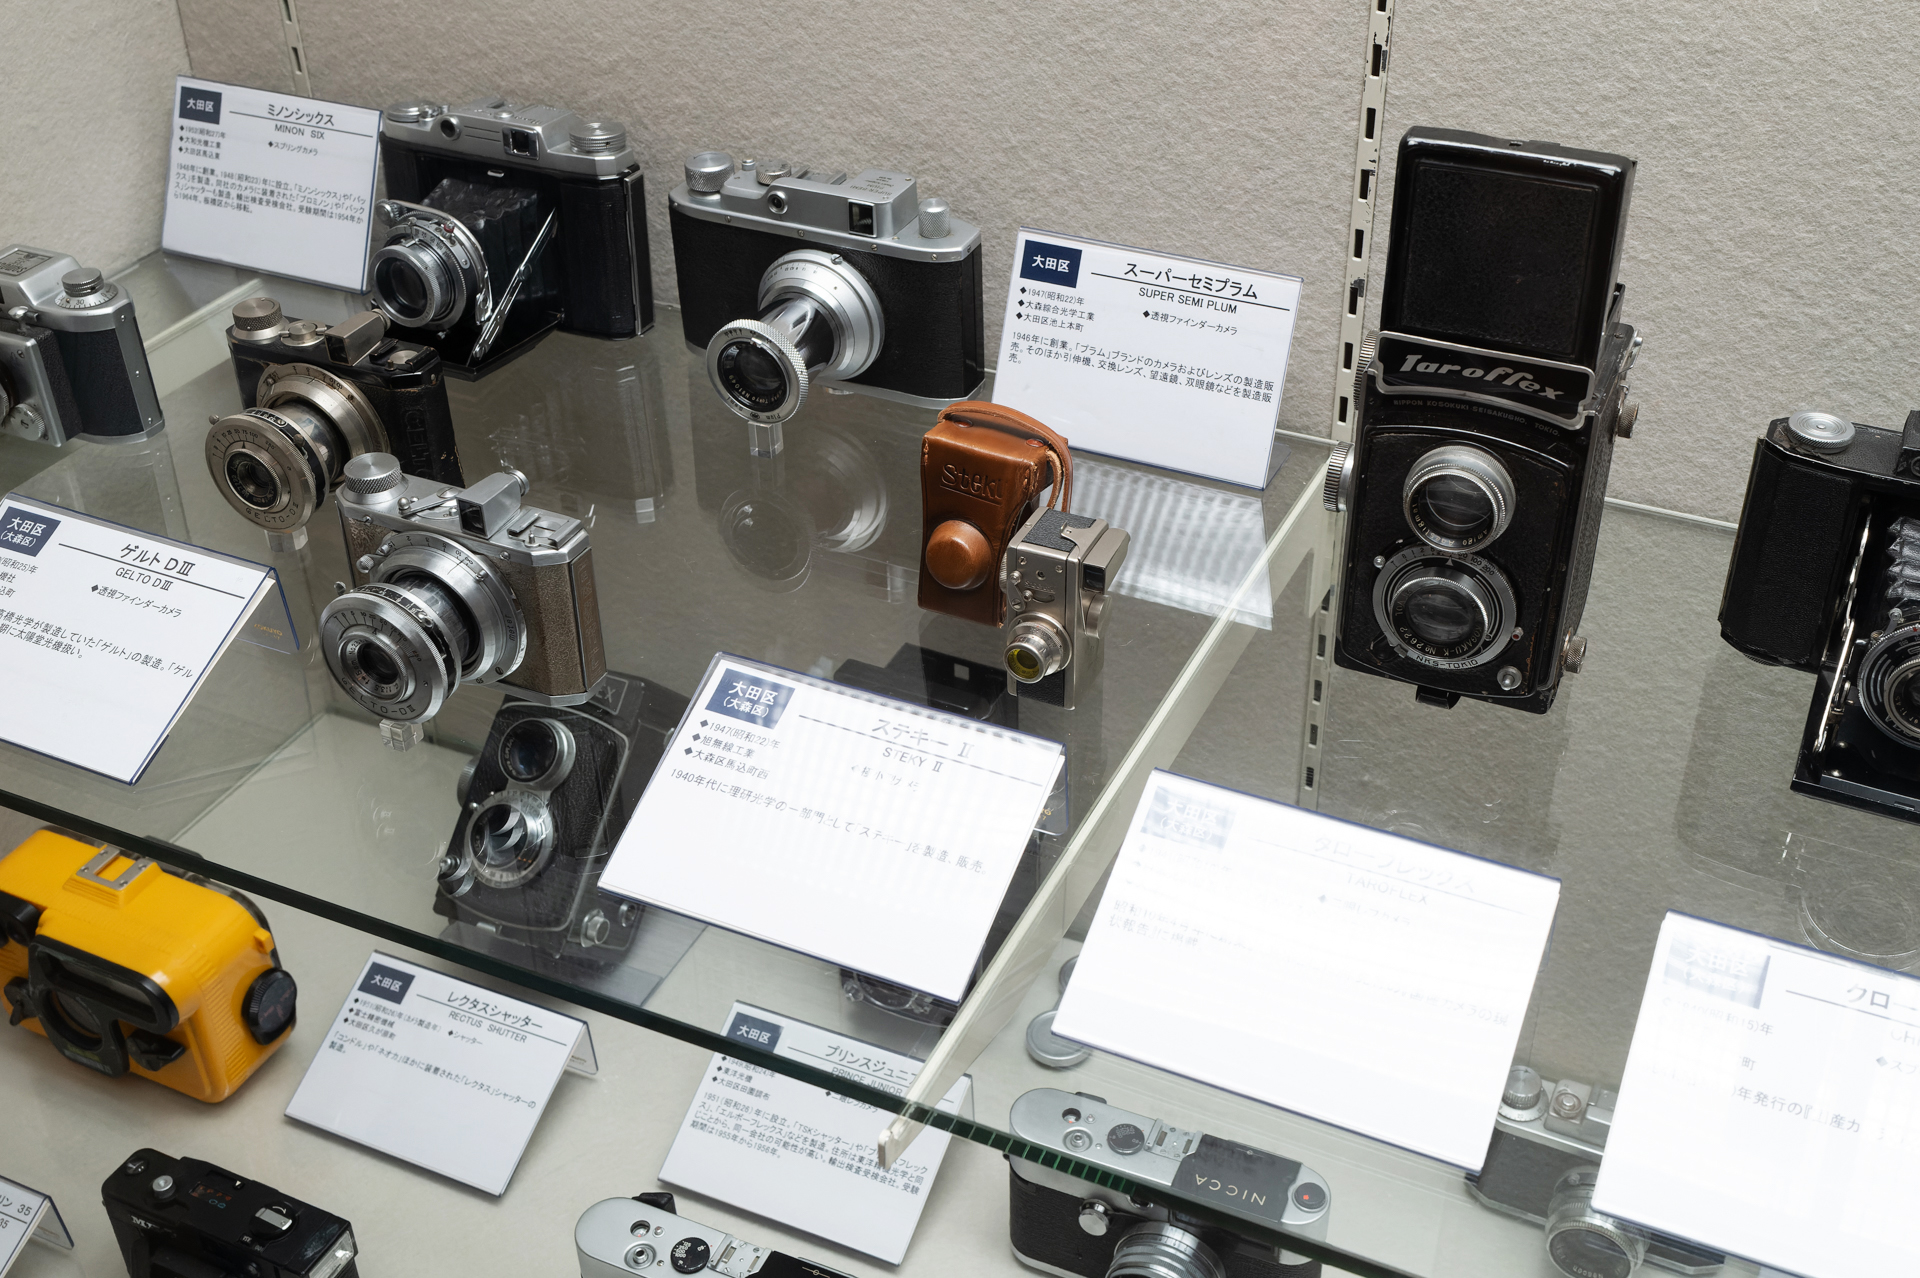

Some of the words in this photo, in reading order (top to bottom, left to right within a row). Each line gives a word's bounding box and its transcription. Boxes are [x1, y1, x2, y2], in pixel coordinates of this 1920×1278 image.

[186, 97, 214, 112] 大田区
[267, 102, 335, 127] ミノンシックス
[274, 123, 304, 136] MINON
[310, 129, 324, 140] SIX
[273, 141, 318, 156] スプリングカメラ
[1031, 254, 1070, 273] 大田区
[1123, 260, 1260, 300] スーパーセミプラム
[1026, 287, 1085, 307] 1947(昭和22)年
[1138, 286, 1175, 302] SUPER
[1177, 293, 1204, 308] SEMI
[1206, 299, 1237, 314] PLUM
[1023, 312, 1084, 332] 大田区池上本町
[1149, 310, 1238, 336] 透視ファインダーカメラ
[1008, 352, 1022, 364] 売。
[6, 515, 47, 536] 大田区
[116, 542, 166, 568] ゲルト
[113, 566, 152, 584] GELTO
[96, 585, 183, 618] 透視ファインダーカメラ
[1416, 654, 1479, 669] NKS-TOKIO
[728, 680, 779, 704] 大田区
[699, 734, 756, 759] 旭無線工業
[706, 721, 781, 751] 1947(昭和22)年
[870, 716, 952, 753] ステキー
[691, 748, 771, 780] 大森区馬込町西
[881, 746, 926, 768] STEKY
[1163, 797, 1220, 826] 大田区
[1344, 871, 1430, 906] TAROFLEX
[1685, 947, 1751, 978] 大田区
[369, 973, 403, 992] 大田区
[446, 990, 545, 1033] レクタスシャッター
[447, 1010, 483, 1028] RECTUS
[486, 1023, 527, 1043] SHUTTER
[452, 1031, 484, 1047] シャッター
[735, 1024, 771, 1044] 大田区
[830, 1066, 865, 1084] PRINCE
[866, 1078, 902, 1096] JUNIOR
[1195, 1173, 1266, 1206] NICCA
[17, 1203, 32, 1216] 35
